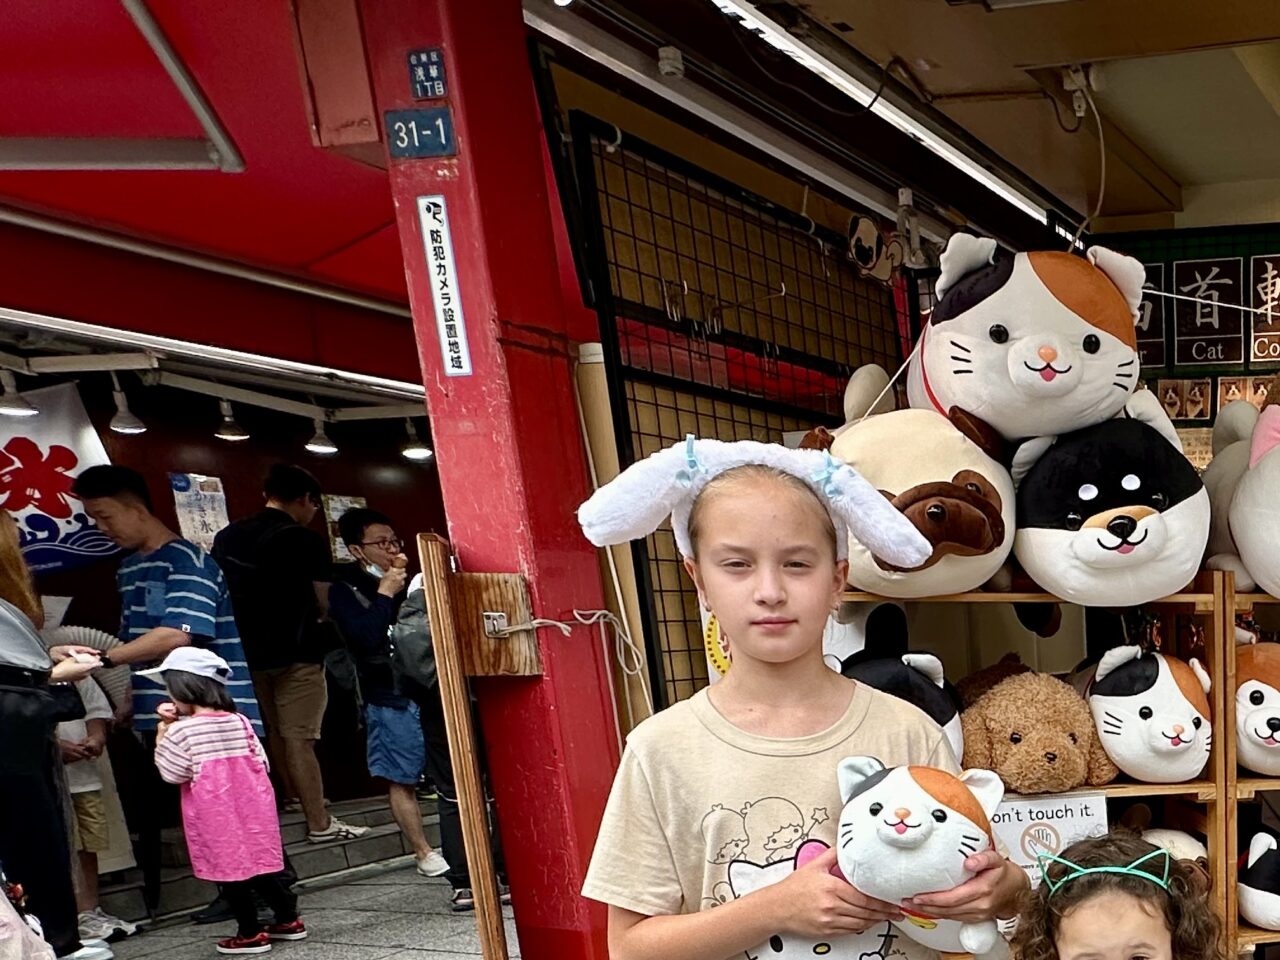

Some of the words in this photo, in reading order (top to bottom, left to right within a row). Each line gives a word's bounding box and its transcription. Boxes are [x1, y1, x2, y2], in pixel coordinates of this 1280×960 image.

[416, 80, 444, 97] 1丁目
[394, 117, 446, 148] 31-1
[429, 229, 464, 370] 防犯カメラ設置地域
[1192, 341, 1225, 361] Cat
[992, 808, 1023, 823] on't
[1028, 804, 1074, 821] touch
[1080, 803, 1094, 817] it.
